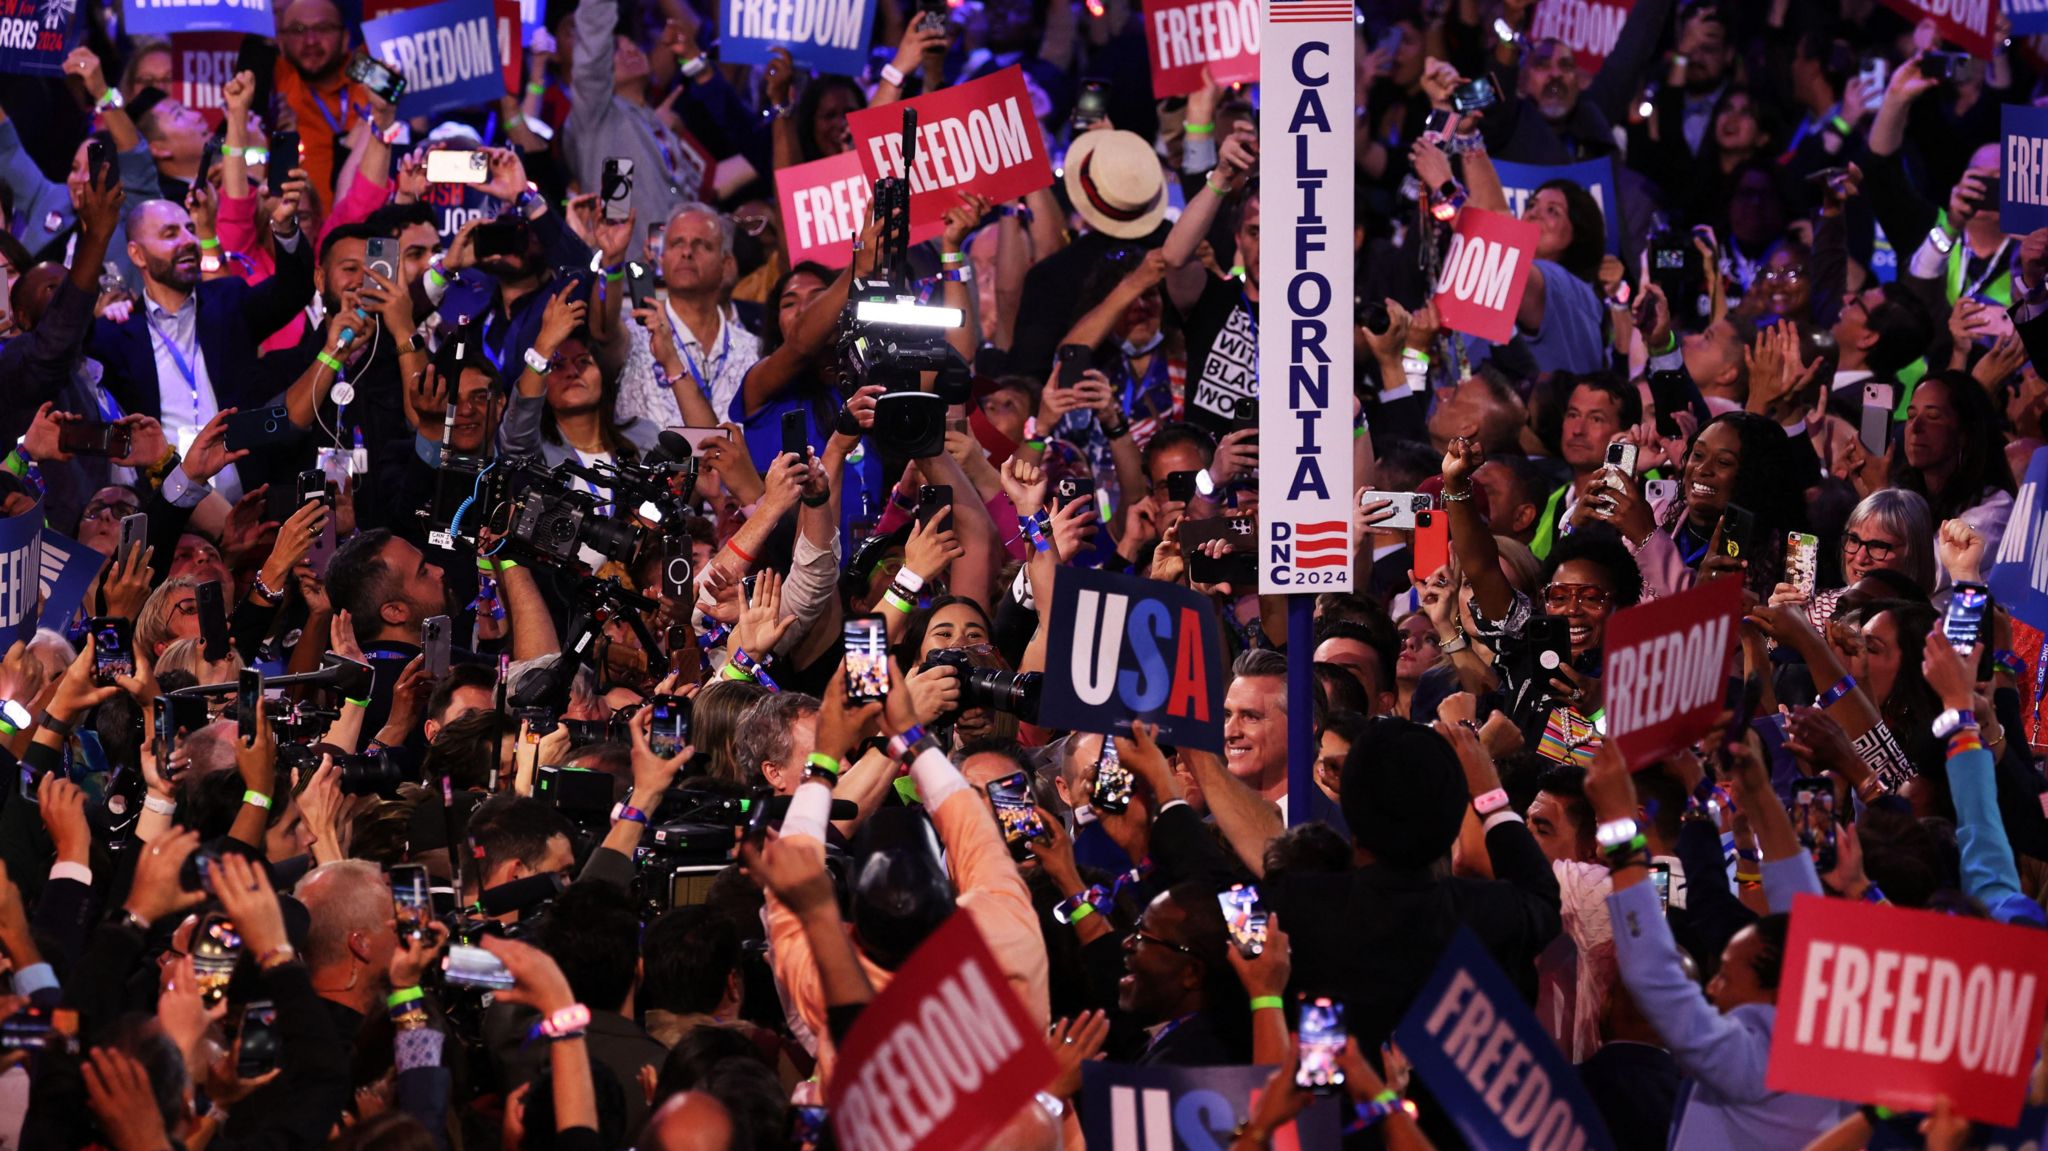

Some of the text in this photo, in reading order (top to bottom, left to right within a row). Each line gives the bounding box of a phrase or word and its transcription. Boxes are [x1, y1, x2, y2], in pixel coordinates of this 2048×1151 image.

[0, 17, 63, 51] RRIS 2024
[381, 16, 494, 93] FREEDOM
[868, 96, 1033, 197] FREEDOM
[1286, 41, 1332, 501] CALIFORNIA
[1270, 521, 1292, 585] DNC
[1295, 571, 1347, 585] 2024
[1072, 589, 1210, 722] USA
[1605, 614, 1730, 738] FREEDOM
[1795, 941, 2037, 1077] FREEDOM
